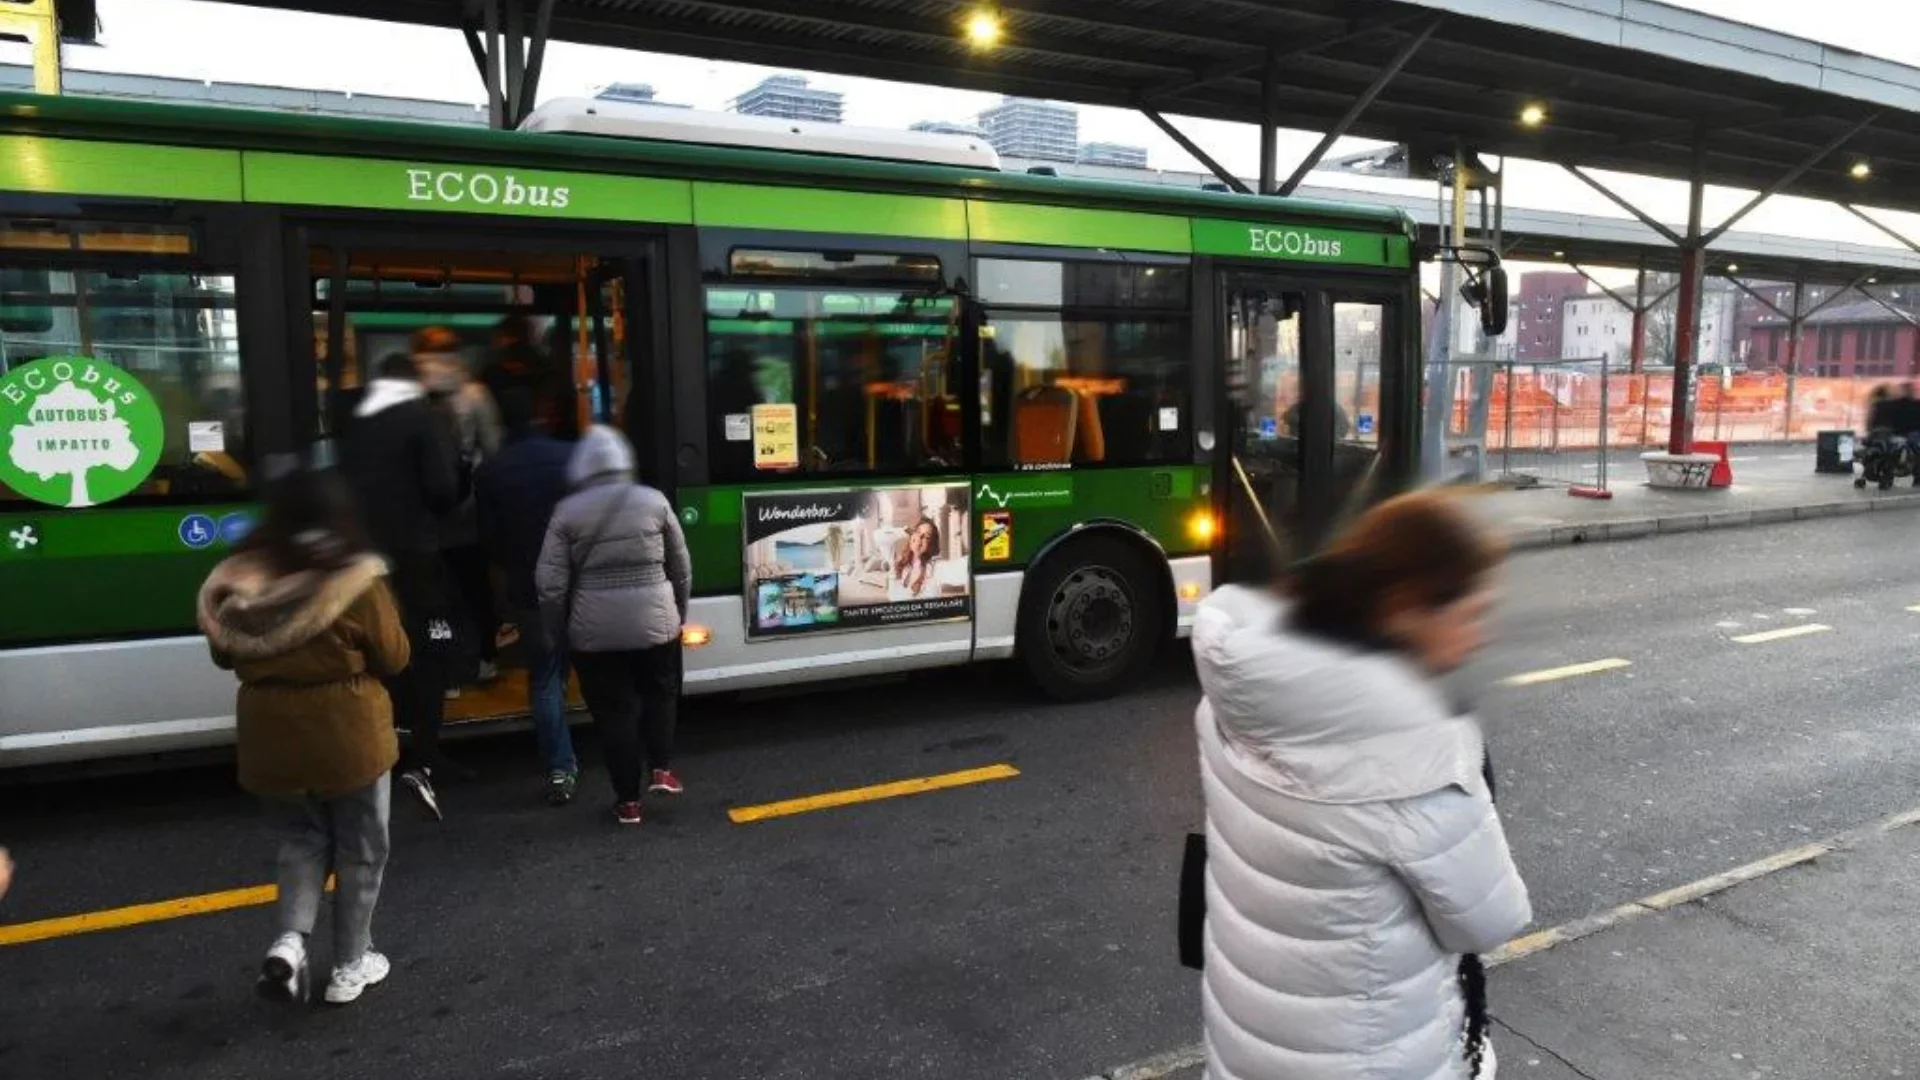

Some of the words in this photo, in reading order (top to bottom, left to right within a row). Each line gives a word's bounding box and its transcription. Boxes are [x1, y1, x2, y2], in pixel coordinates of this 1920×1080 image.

[406, 168, 570, 208] ECObus
[1248, 228, 1342, 257] ECObus
[1, 362, 137, 405] ECObus
[35, 408, 109, 422] AUTOBUS
[36, 438, 111, 452] IMPATTO
[758, 502, 838, 521] Wonderbox
